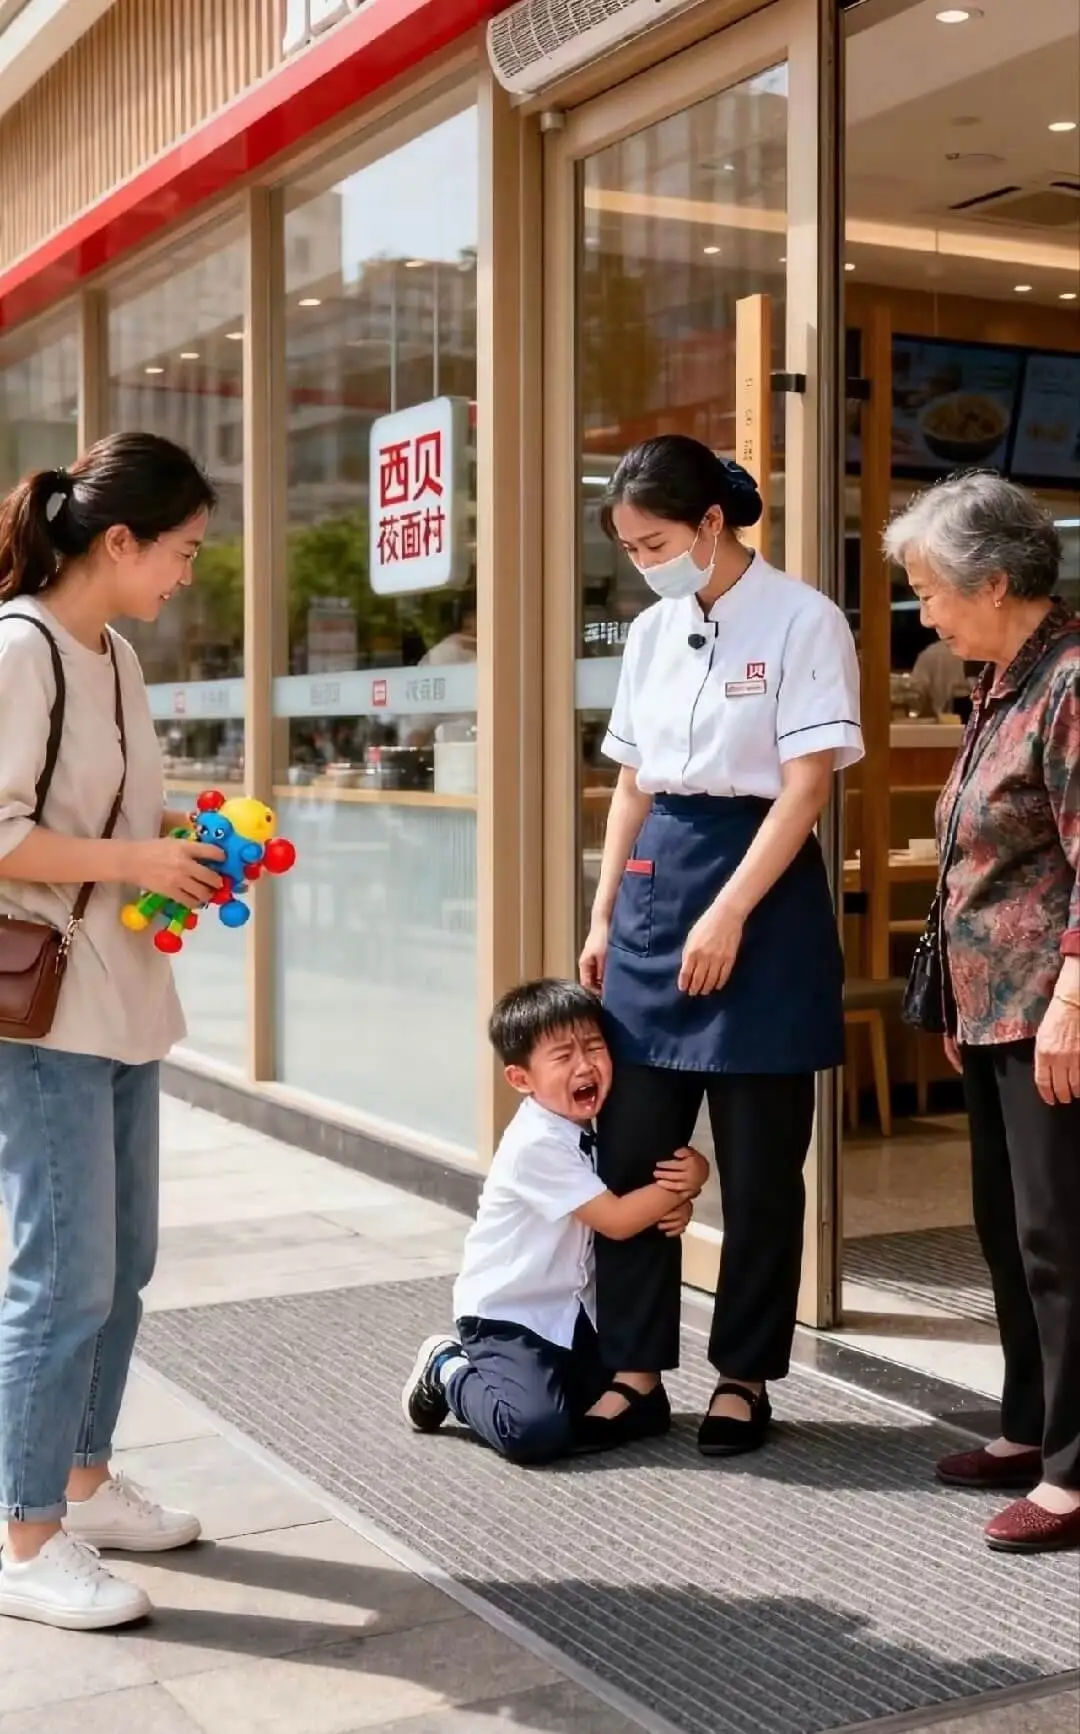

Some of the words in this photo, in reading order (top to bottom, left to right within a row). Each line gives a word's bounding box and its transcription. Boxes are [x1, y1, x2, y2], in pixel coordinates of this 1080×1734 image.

[379, 431, 444, 508] 西贝
[377, 505, 445, 565] 莜面村
